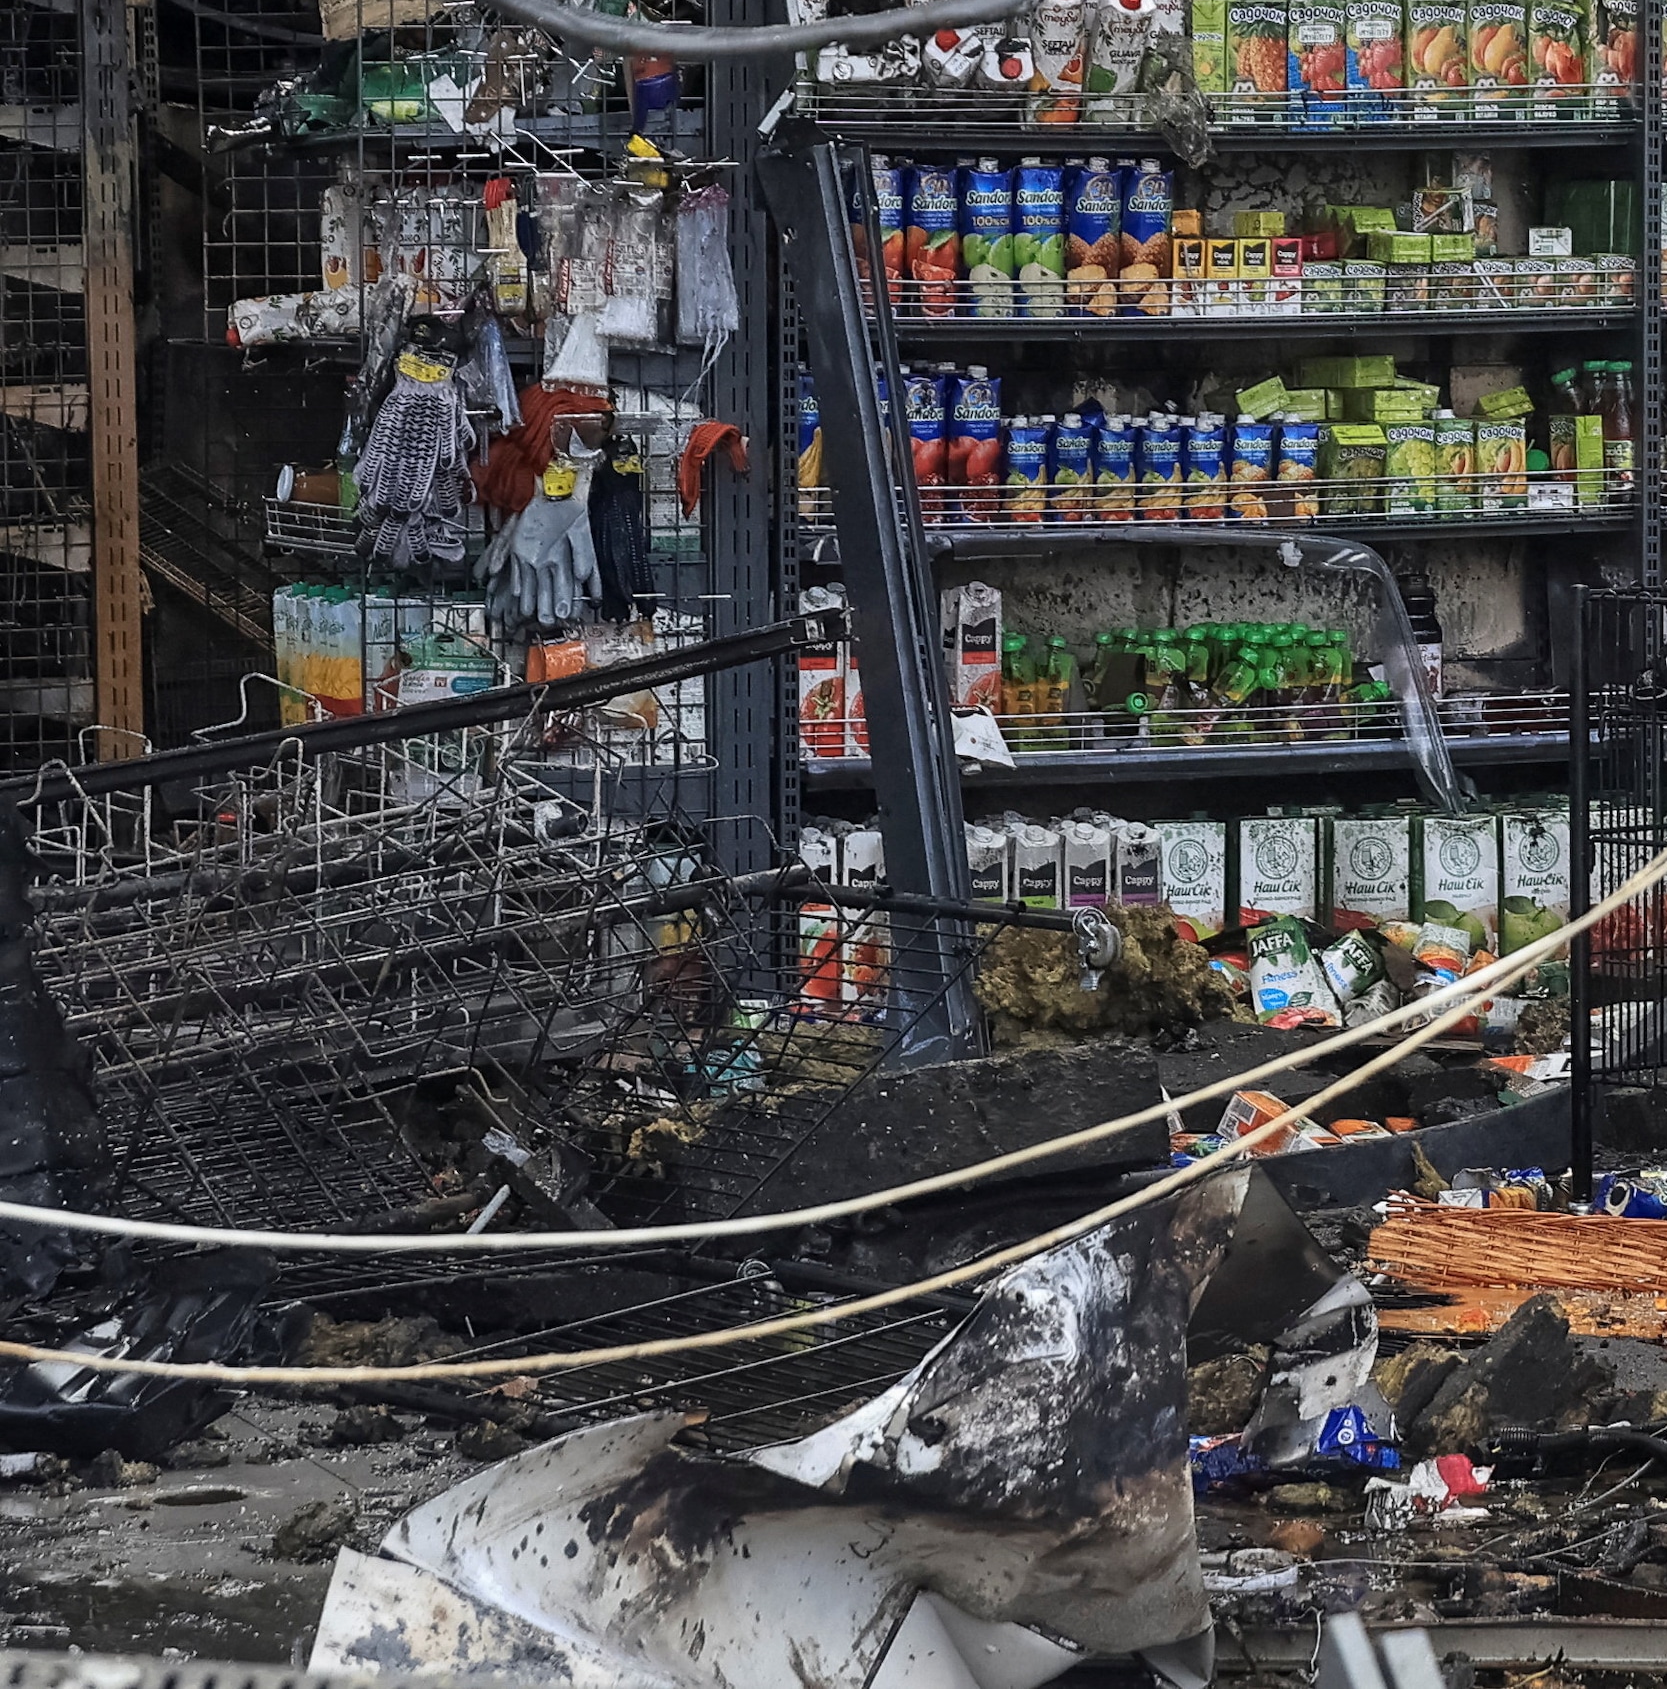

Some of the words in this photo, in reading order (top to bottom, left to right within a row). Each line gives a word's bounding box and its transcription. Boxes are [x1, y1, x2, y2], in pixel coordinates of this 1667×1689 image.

[1230, 8, 1285, 24] Садочок
[1289, 9, 1344, 23] Садочок
[1346, 3, 1399, 17] Садочок
[1411, 8, 1465, 22] Садочок
[1470, 5, 1525, 20] Садочок
[1388, 427, 1434, 442] Садочок
[1479, 426, 1525, 441] Садочок
[965, 634, 992, 644] Cappy
[972, 878, 999, 890] Cappy
[1023, 878, 1052, 889] Cappy
[1072, 875, 1102, 887] Cappy
[1124, 875, 1154, 886] Cappy
[1254, 880, 1278, 894] Наш
[1281, 880, 1300, 894] Сік
[1347, 881, 1374, 895] Наш
[1376, 880, 1396, 894] Сік
[1439, 878, 1462, 891] Наш
[1464, 878, 1484, 891] Сік
[1516, 875, 1541, 888] Наш
[1166, 881, 1190, 897] Наш
[1191, 883, 1212, 897] Сік
[1251, 933, 1295, 957] JAFFA
[1342, 937, 1374, 976] JAFFA
[1261, 970, 1299, 984] Fitness
